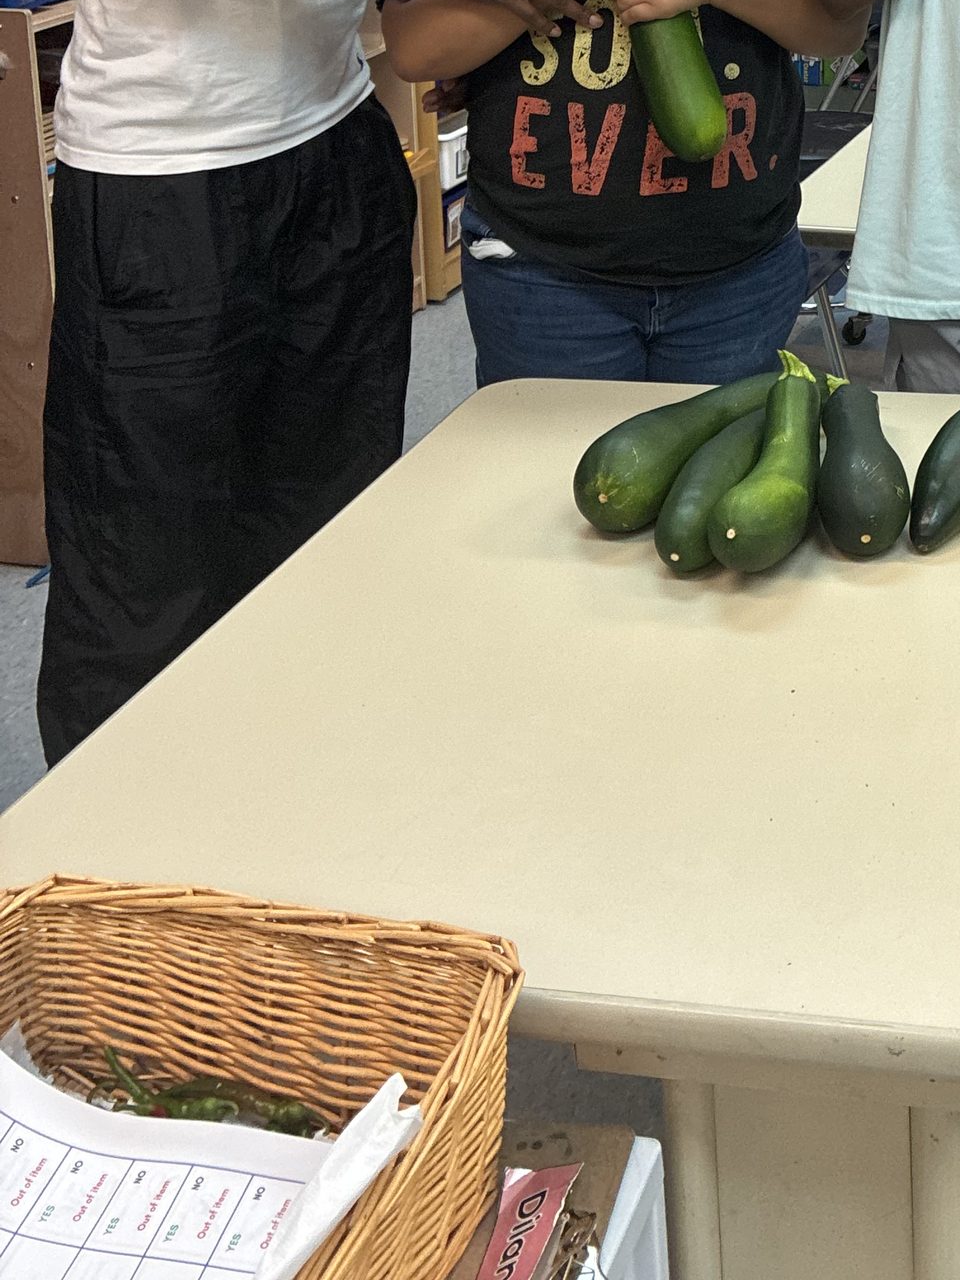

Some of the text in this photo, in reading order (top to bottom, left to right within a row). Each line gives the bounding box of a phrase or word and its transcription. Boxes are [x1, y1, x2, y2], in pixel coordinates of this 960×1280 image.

[10, 1138, 24, 1153] NO
[70, 1160, 83, 1174] NO
[11, 1157, 48, 1207] Out of item
[133, 1170, 147, 1184] NO
[191, 1176, 205, 1191] NO
[72, 1173, 108, 1222] Out of item
[253, 1186, 266, 1200] NO
[38, 1205, 55, 1223] YES
[137, 1179, 171, 1231] Out of item
[197, 1188, 230, 1240] Out of item
[103, 1217, 120, 1236] YES
[260, 1198, 292, 1249] Out of item
[163, 1224, 179, 1243] YES
[225, 1233, 242, 1252] YES
